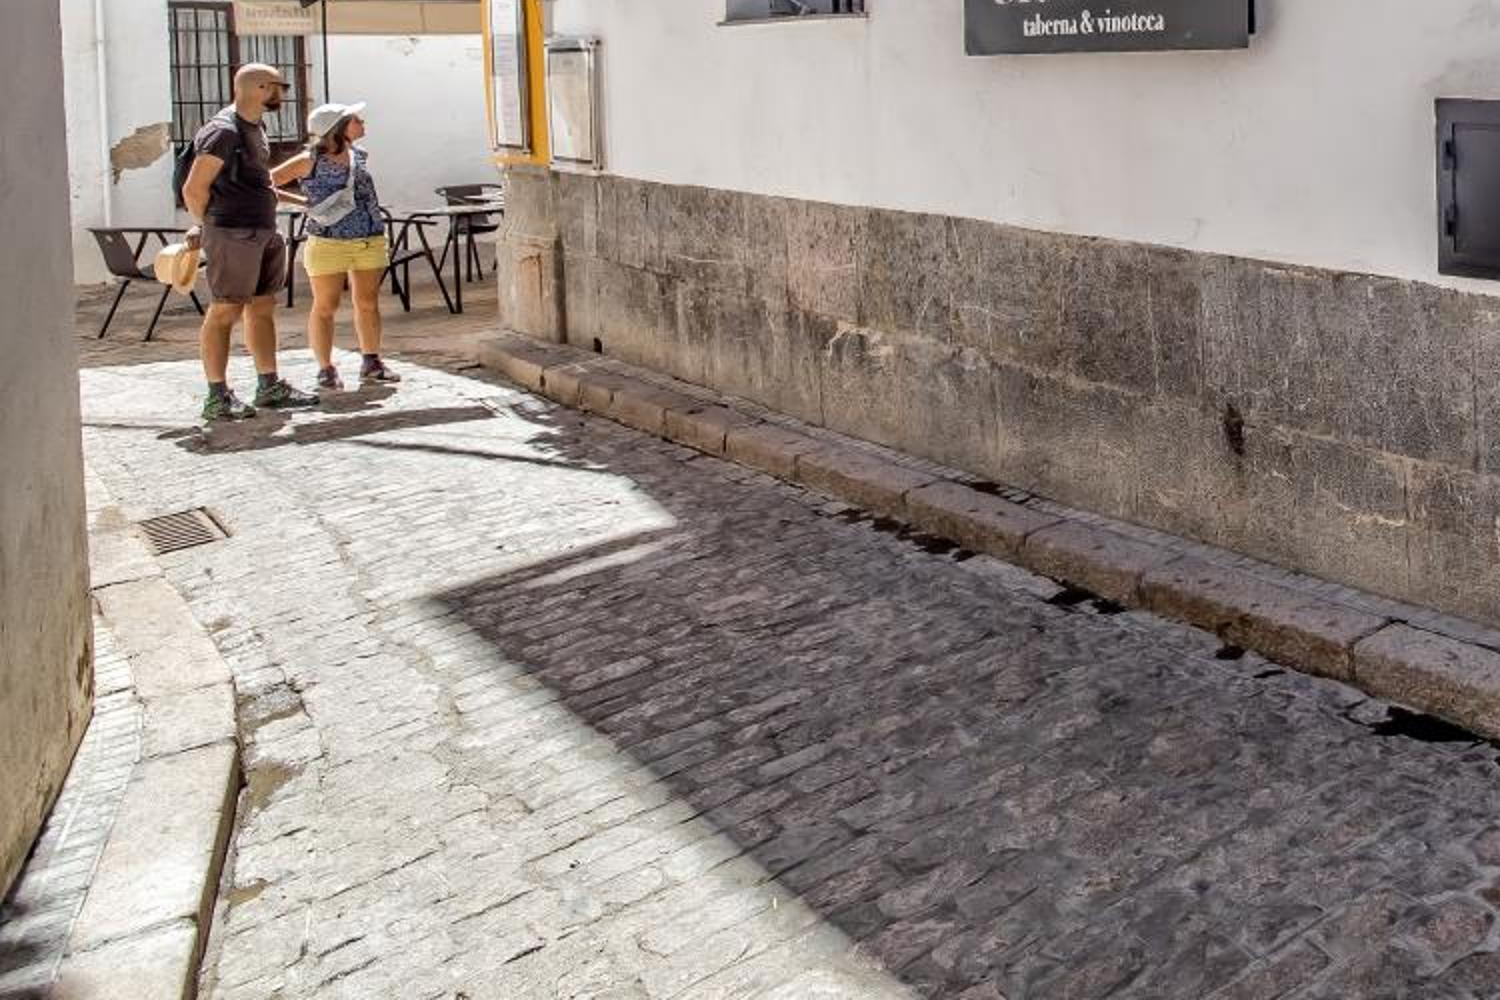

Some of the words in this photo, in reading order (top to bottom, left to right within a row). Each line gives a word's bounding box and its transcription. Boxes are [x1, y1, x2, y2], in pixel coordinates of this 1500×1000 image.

[1023, 12, 1078, 37] taberna
[1081, 9, 1095, 34] &
[1097, 9, 1165, 34] vinoteca
